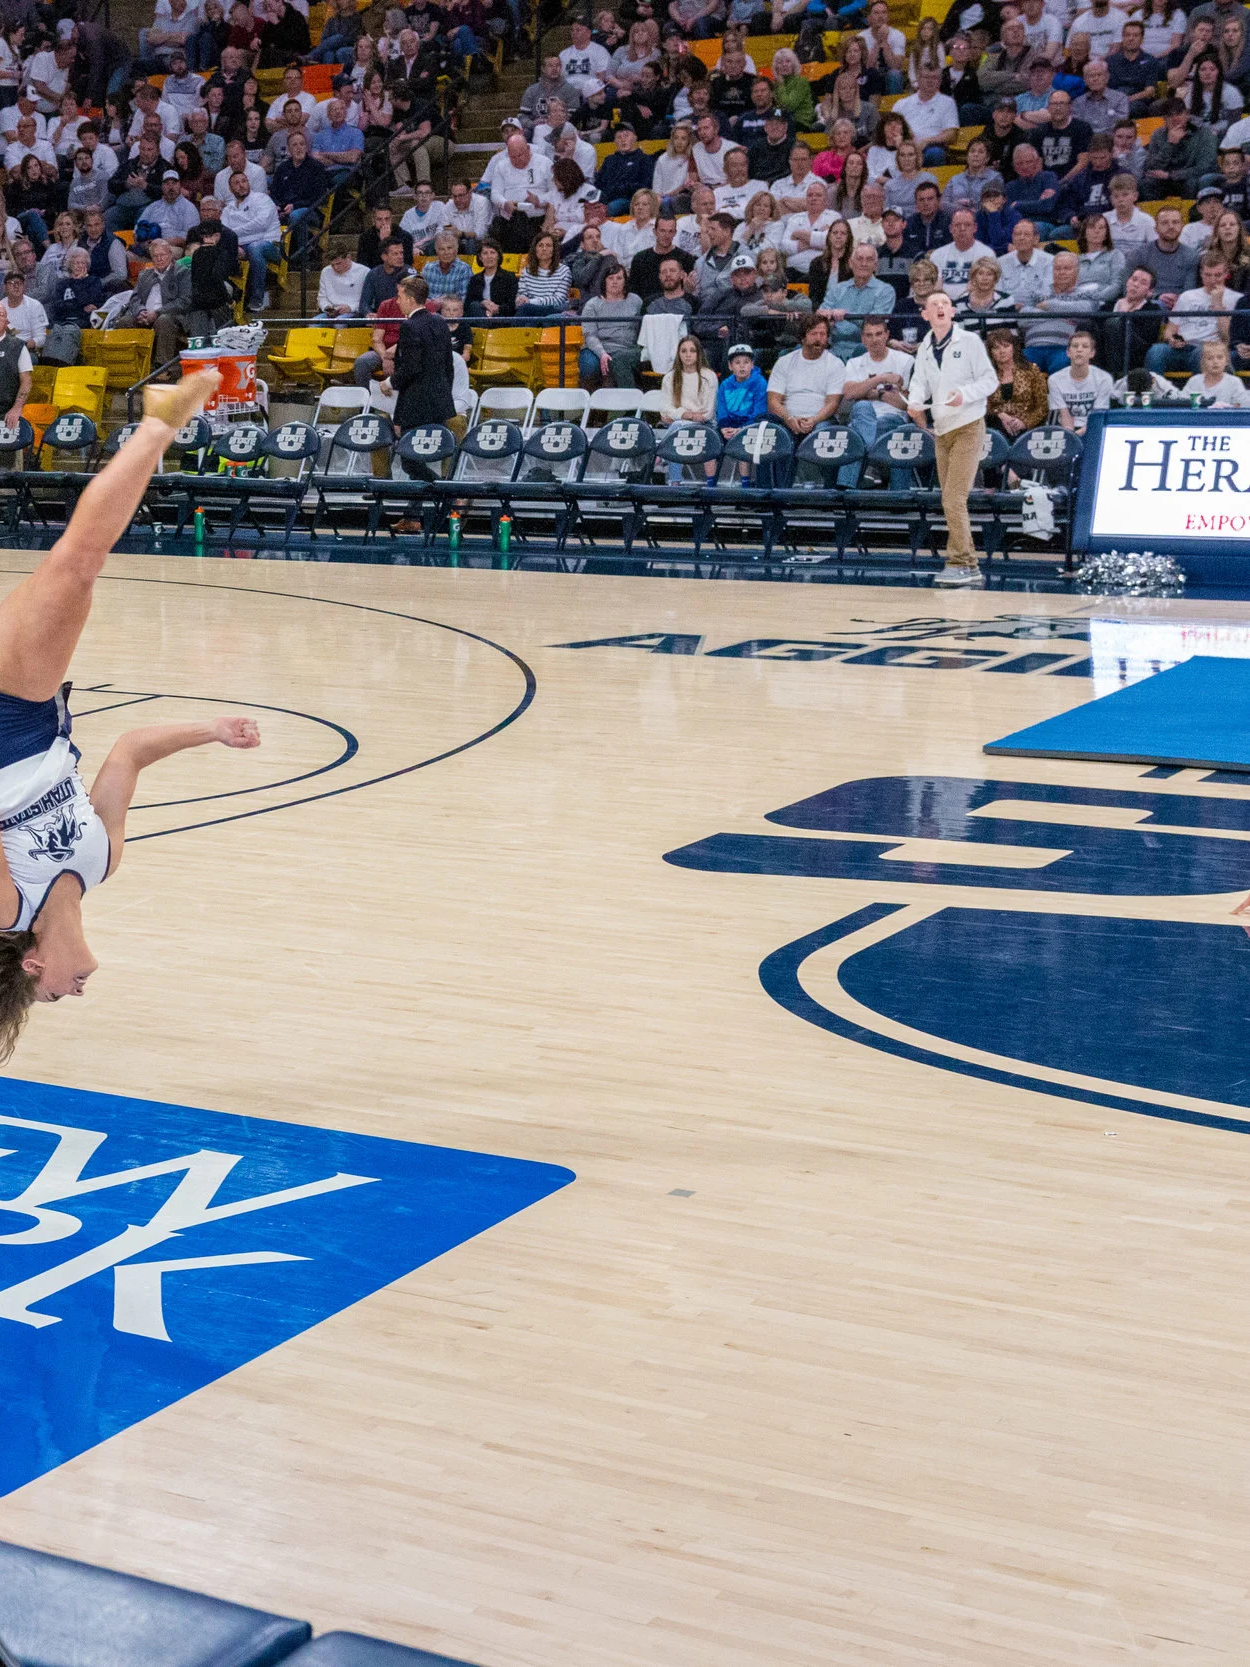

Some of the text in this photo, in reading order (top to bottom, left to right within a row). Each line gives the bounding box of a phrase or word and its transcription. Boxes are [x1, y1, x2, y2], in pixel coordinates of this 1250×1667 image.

[1188, 435, 1231, 451] THE
[1185, 513, 1250, 532] EMPO
[41, 778, 77, 814] UTAH
